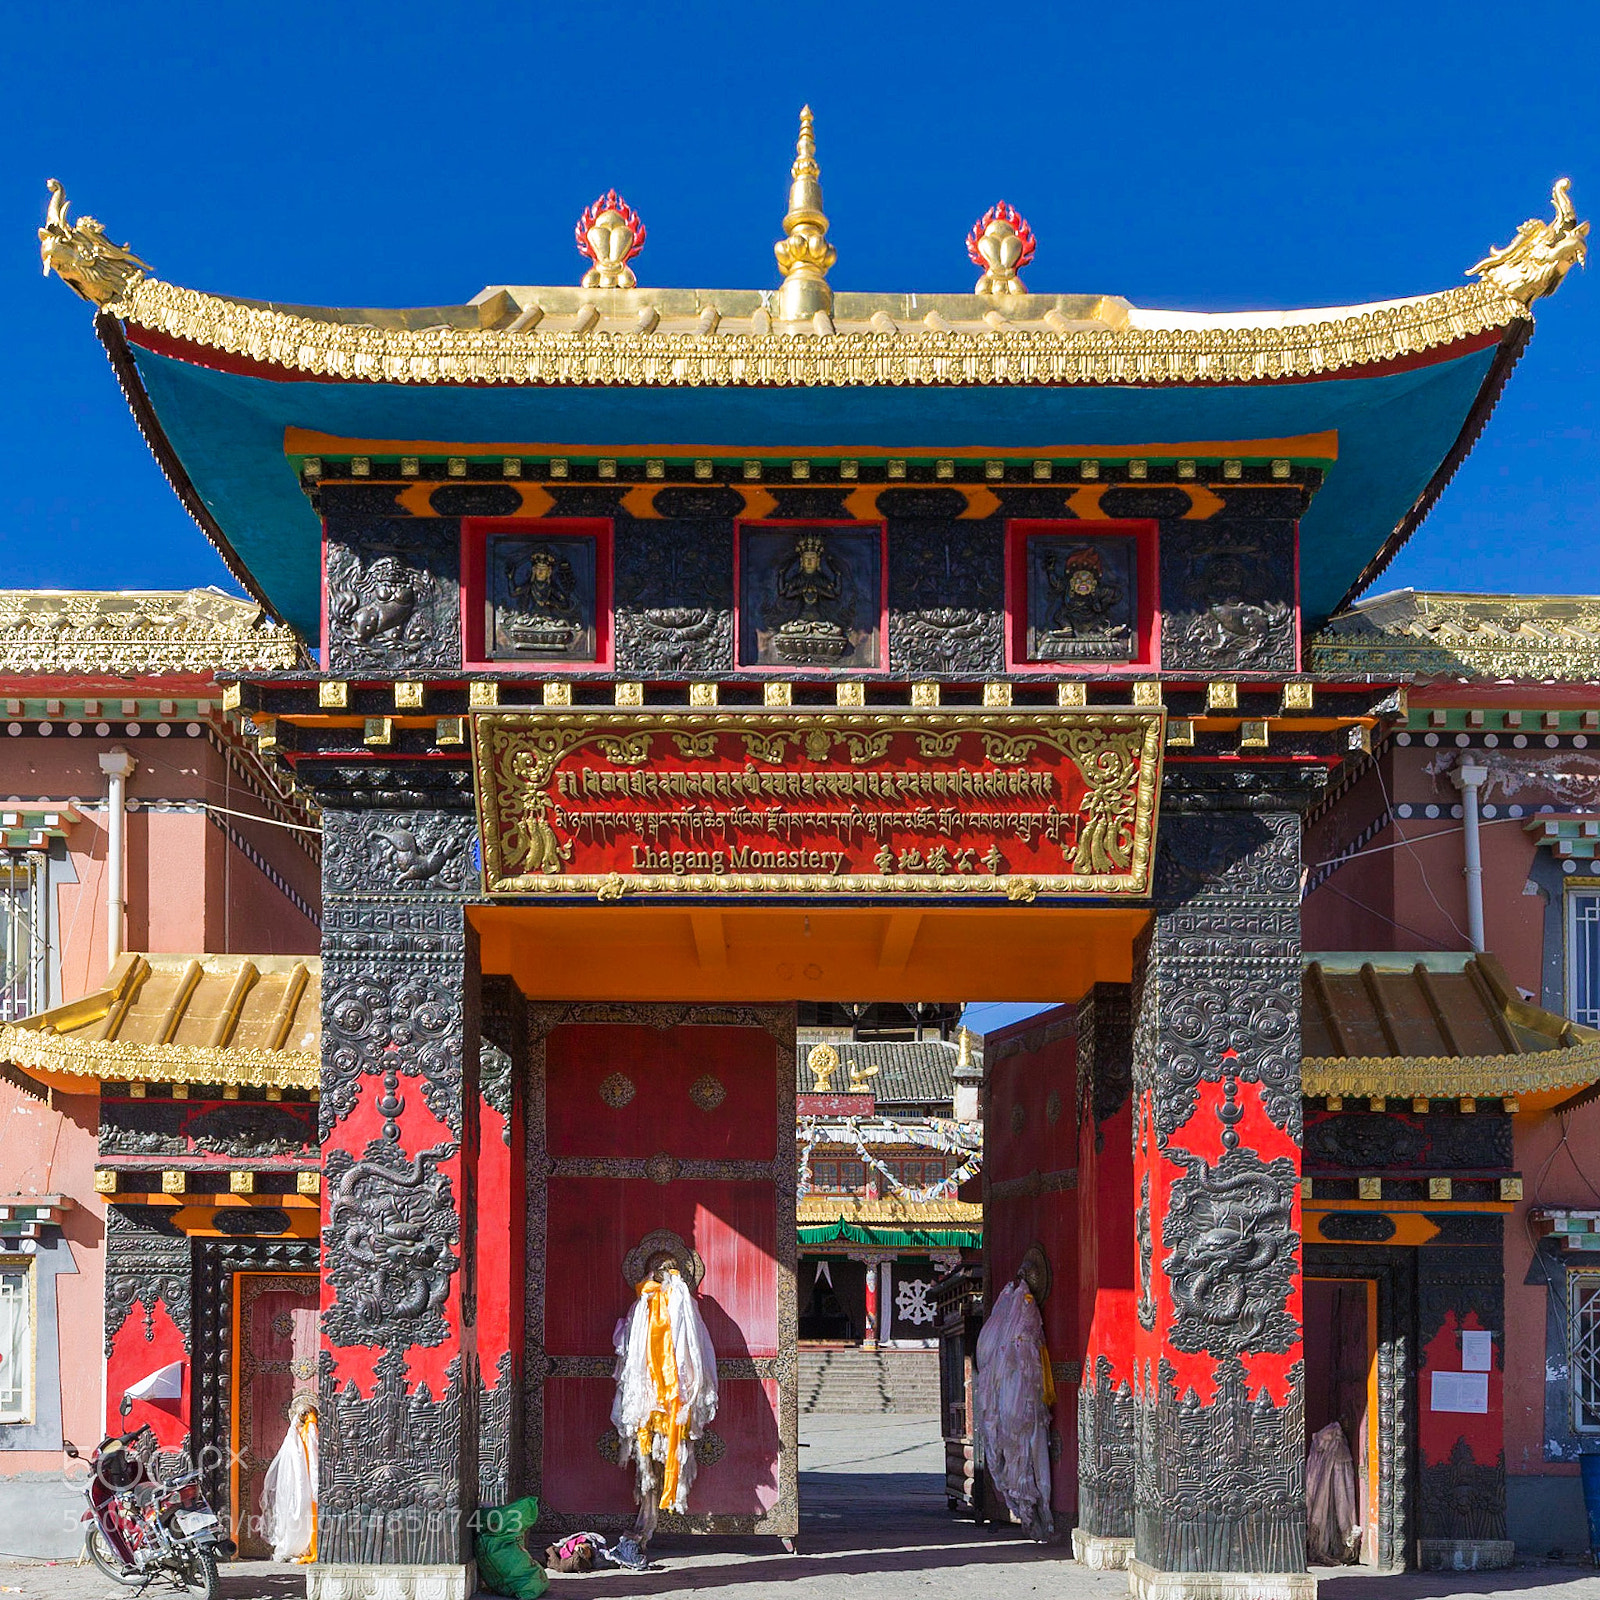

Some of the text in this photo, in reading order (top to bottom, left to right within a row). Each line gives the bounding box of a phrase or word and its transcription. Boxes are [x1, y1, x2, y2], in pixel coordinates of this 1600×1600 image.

[631, 845, 845, 875] Lhagang Monastery
[873, 844, 1003, 874] 圣地塔公寺
